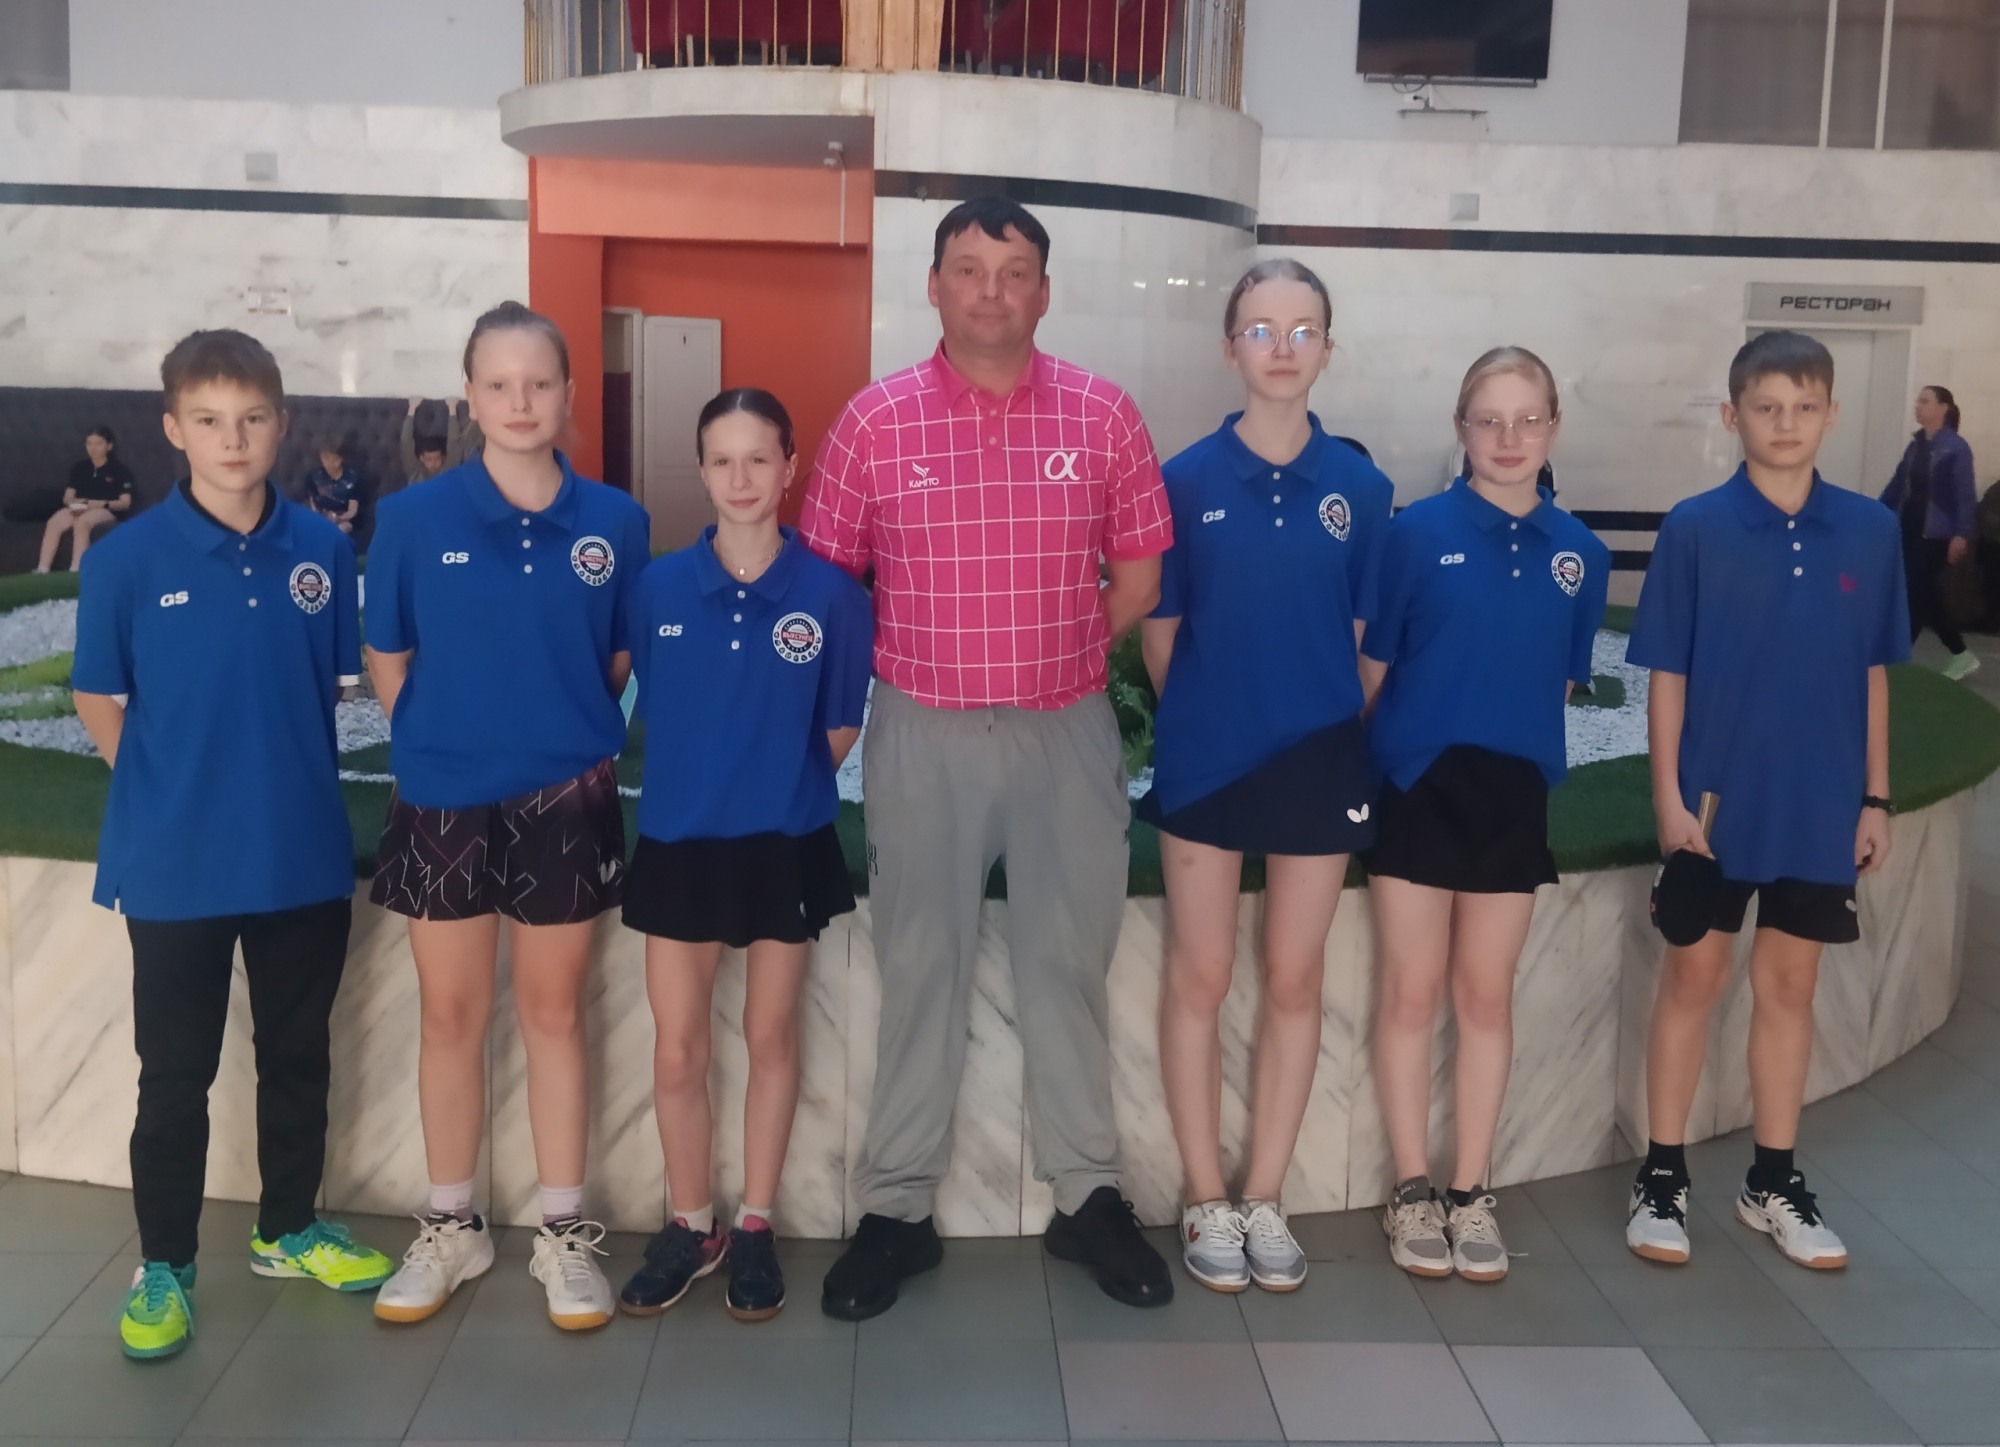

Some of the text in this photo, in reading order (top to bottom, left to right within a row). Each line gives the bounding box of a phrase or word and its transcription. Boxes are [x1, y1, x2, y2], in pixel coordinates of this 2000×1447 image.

[909, 477, 939, 488] KAMITO
[1202, 509, 1226, 523] GS
[442, 552, 469, 564] GS
[1440, 553, 1465, 565] GS
[160, 590, 189, 607] GS
[659, 624, 683, 636] GS
